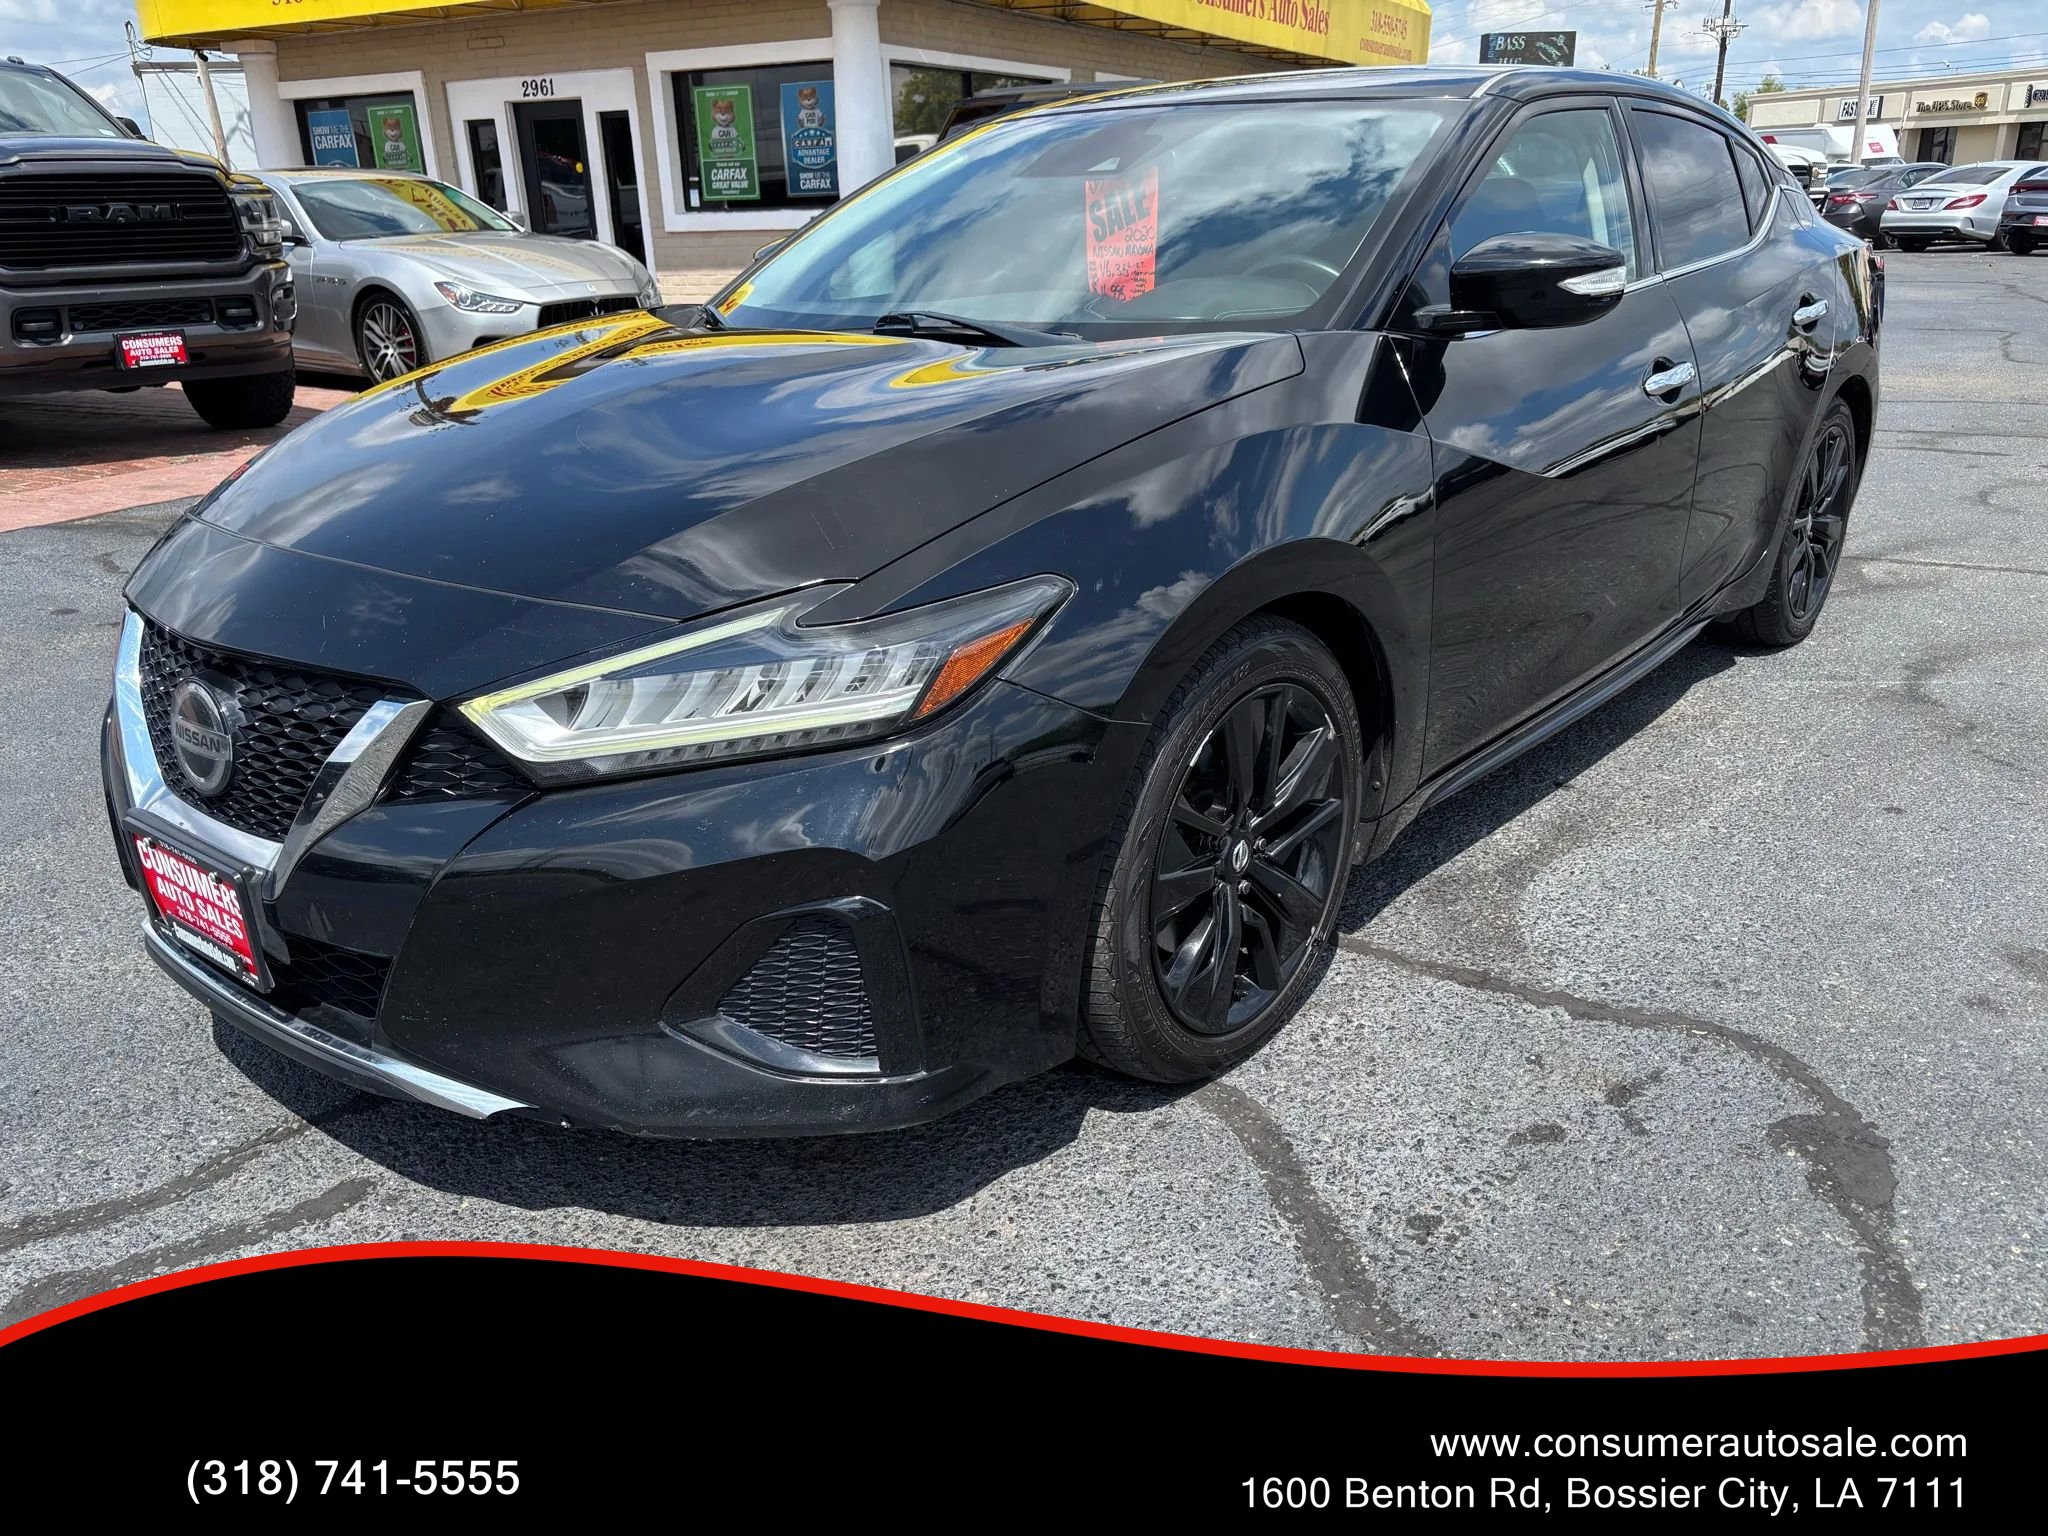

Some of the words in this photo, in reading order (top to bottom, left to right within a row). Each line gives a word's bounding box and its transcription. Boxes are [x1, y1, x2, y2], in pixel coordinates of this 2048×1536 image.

[1267, 0, 1298, 27] Auto
[1300, 0, 1329, 35] Sales
[521, 78, 555, 98] 2961
[1916, 101, 1931, 112] The
[1932, 100, 1950, 112] UPS
[1950, 99, 1973, 111] Store
[312, 126, 330, 135] SHOW
[339, 124, 352, 134] THE
[718, 129, 731, 138] CAR
[314, 134, 353, 150] CARFAX
[797, 148, 831, 157] ADVANTAGE
[803, 156, 825, 165] DEALER
[711, 168, 748, 181] CARFAX
[712, 181, 730, 189] GREAT
[730, 180, 749, 189] VALUE
[800, 178, 832, 190] CARFAX
[66, 202, 173, 222] RAM
[1089, 188, 1151, 243] SALE
[1125, 224, 1156, 242] 2020
[122, 336, 183, 350] CONSUMERS
[130, 347, 153, 357] AUTO
[153, 345, 179, 355] SALES
[175, 720, 221, 754] NISSAN
[136, 839, 244, 921] CONSUMERS
[156, 876, 195, 913] AUTO
[196, 898, 244, 940] SALES
